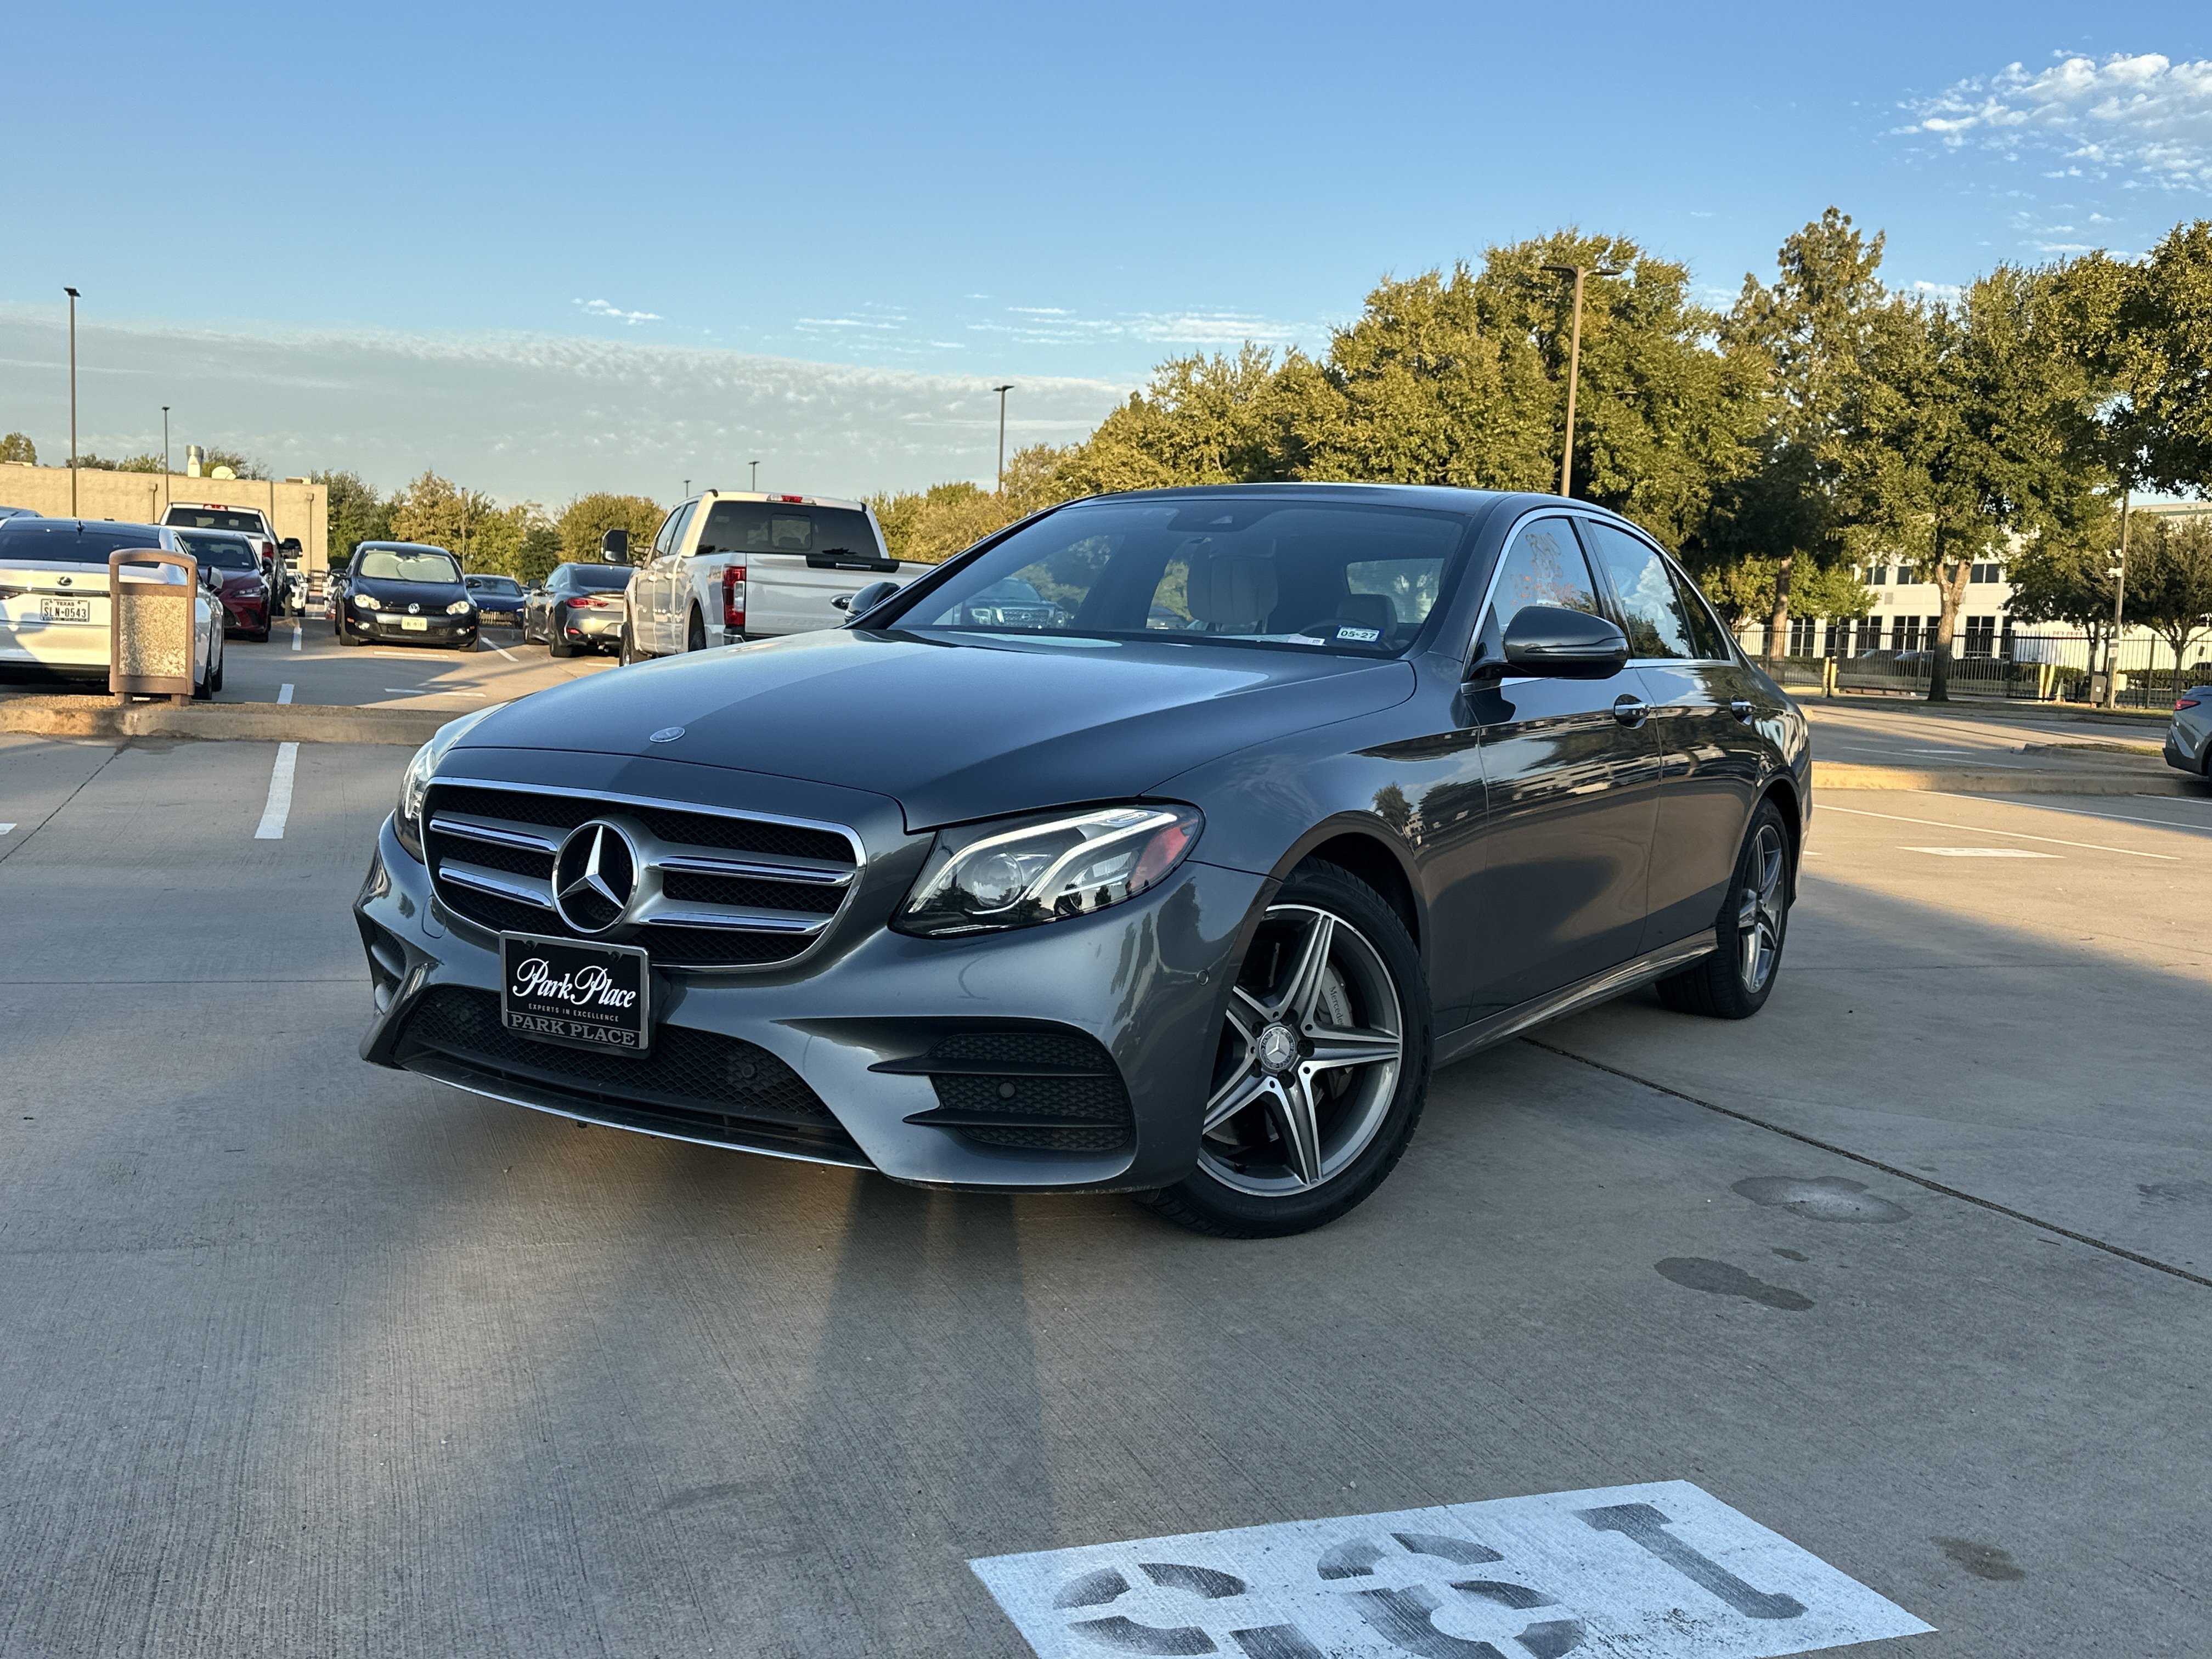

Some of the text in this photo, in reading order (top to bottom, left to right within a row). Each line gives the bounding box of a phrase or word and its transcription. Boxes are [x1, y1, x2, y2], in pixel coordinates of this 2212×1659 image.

[512, 958, 636, 1007] Park Place
[528, 1003, 559, 1013] EXPERTS
[573, 1010, 619, 1022] EXCELLENCE
[511, 1014, 635, 1046] PARK PLACE
